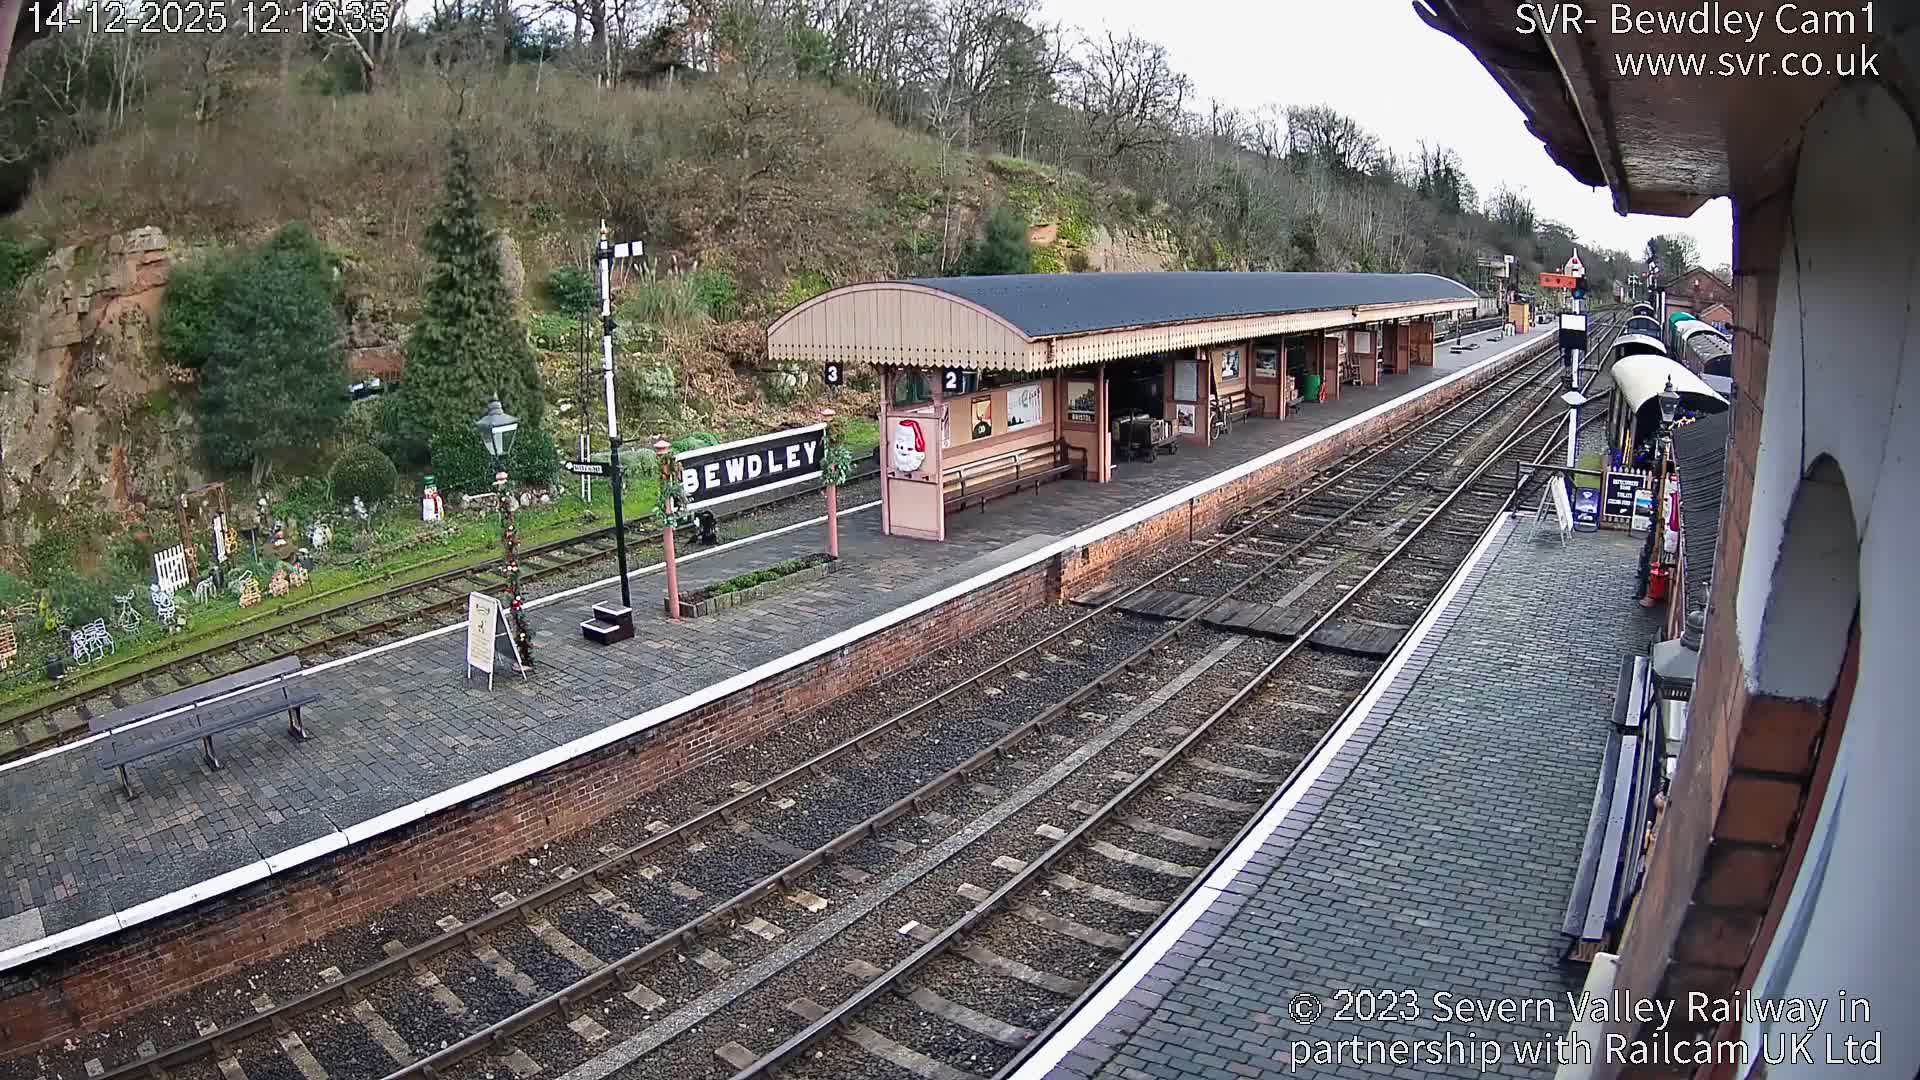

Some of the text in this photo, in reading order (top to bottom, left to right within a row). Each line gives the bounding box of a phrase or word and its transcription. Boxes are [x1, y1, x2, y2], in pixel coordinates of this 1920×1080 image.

[827, 365, 839, 382] 3
[945, 371, 957, 389] 2
[681, 440, 817, 495] BEWDLEY
